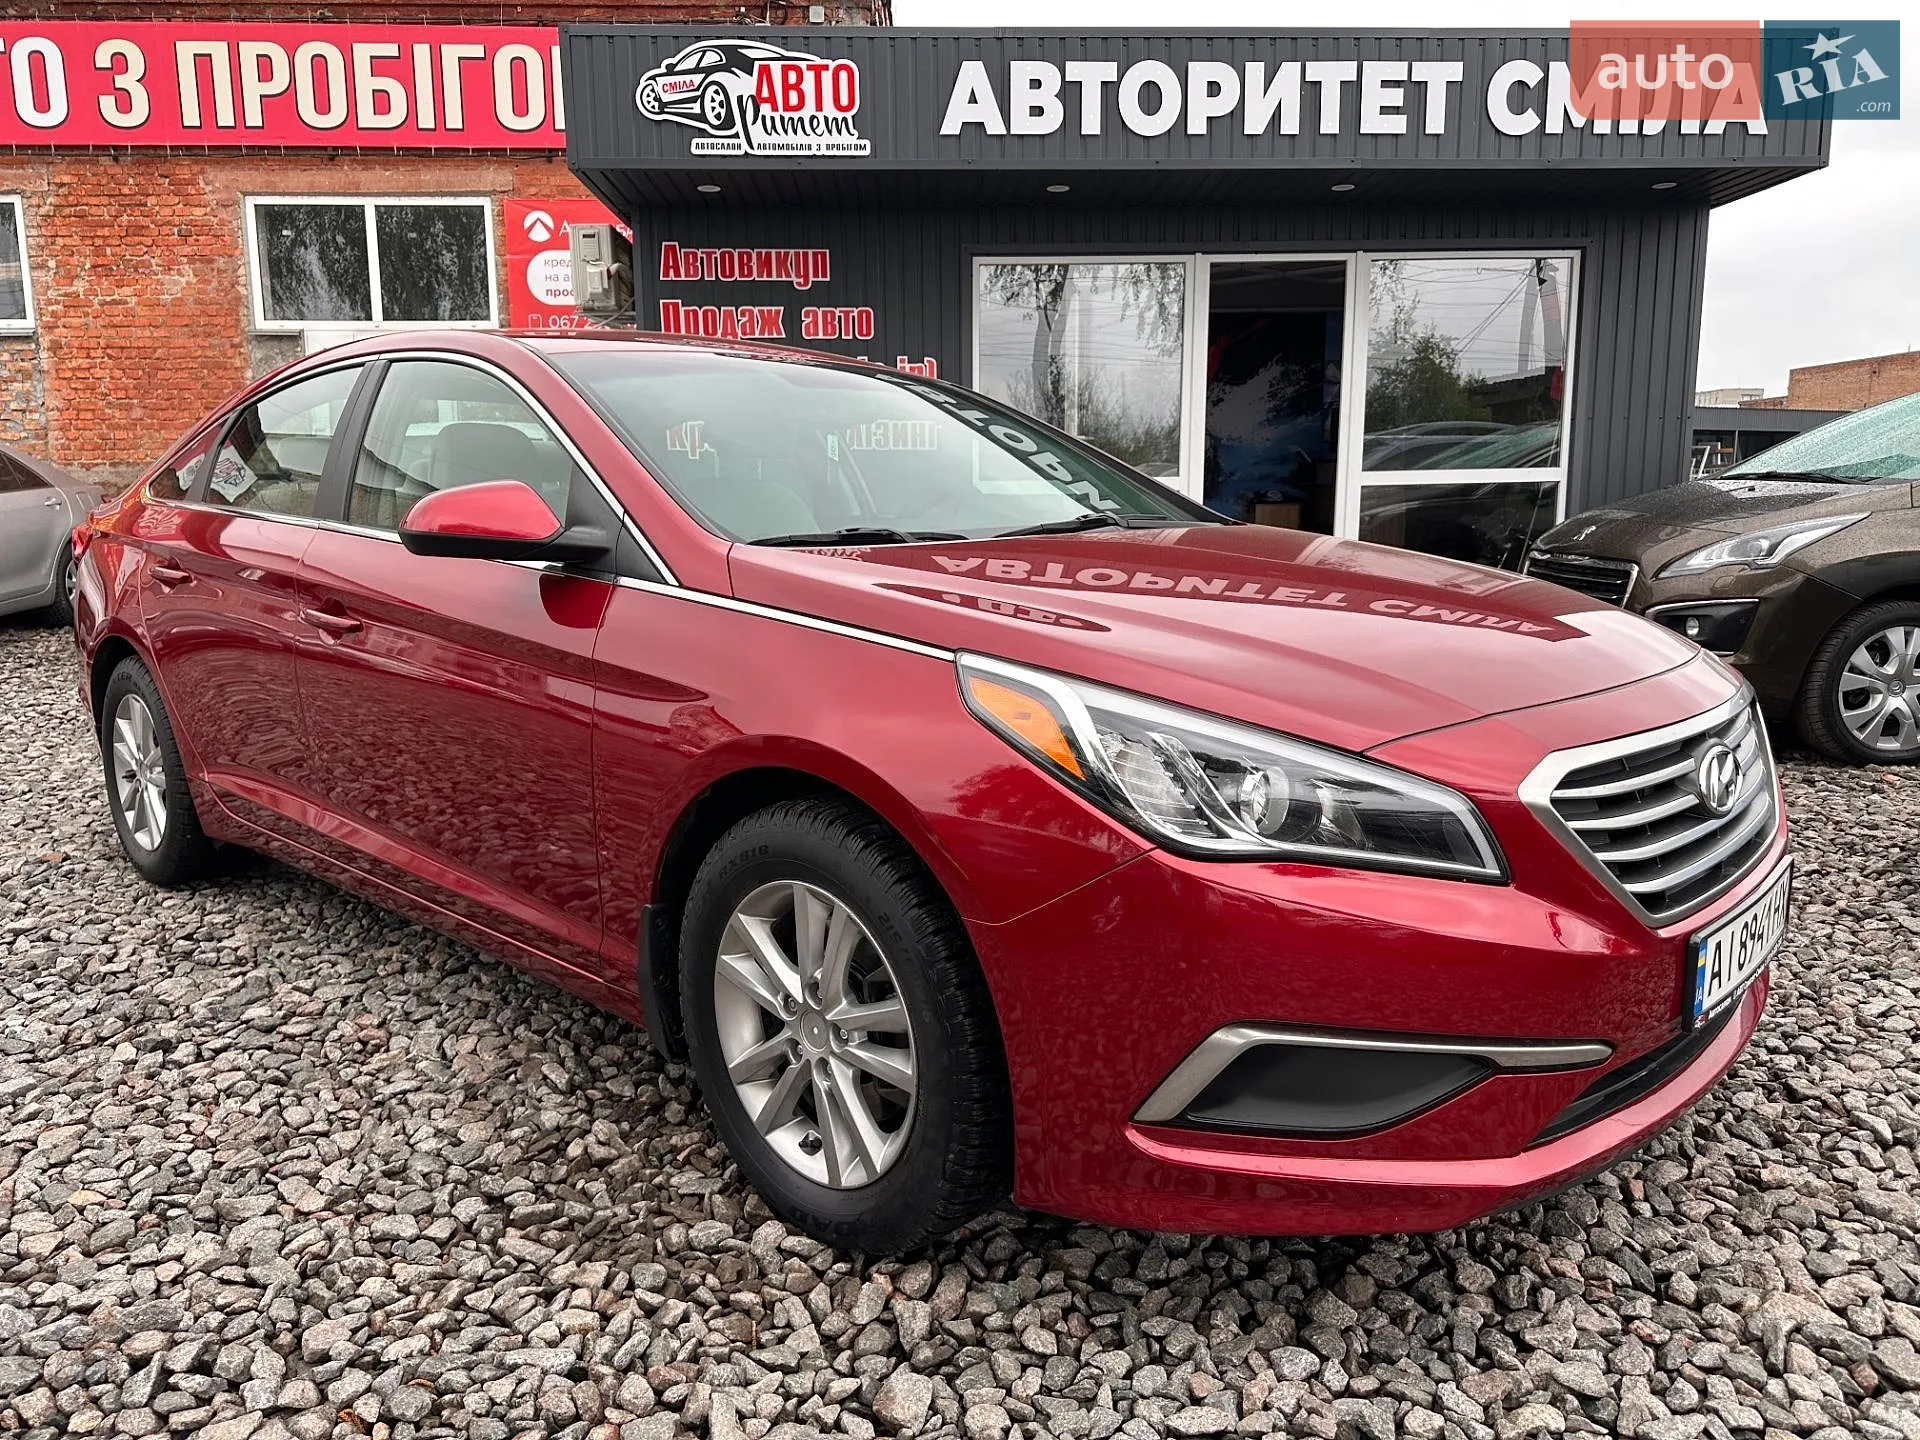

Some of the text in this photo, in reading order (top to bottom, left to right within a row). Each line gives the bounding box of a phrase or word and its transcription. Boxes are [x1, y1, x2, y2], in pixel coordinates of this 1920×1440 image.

[0, 36, 565, 130] О З ПРОБІГО
[755, 63, 856, 113] АВТО
[940, 59, 1769, 136] АВТОРИТЕТ СМІЛА
[695, 142, 742, 151] АВТОСАЛОН
[756, 142, 812, 152] АВТОМОБІЛІВ
[826, 143, 867, 152] ПРОБІГОМ
[660, 242, 831, 290] Автовикуп
[660, 299, 875, 340] Продаж авто
